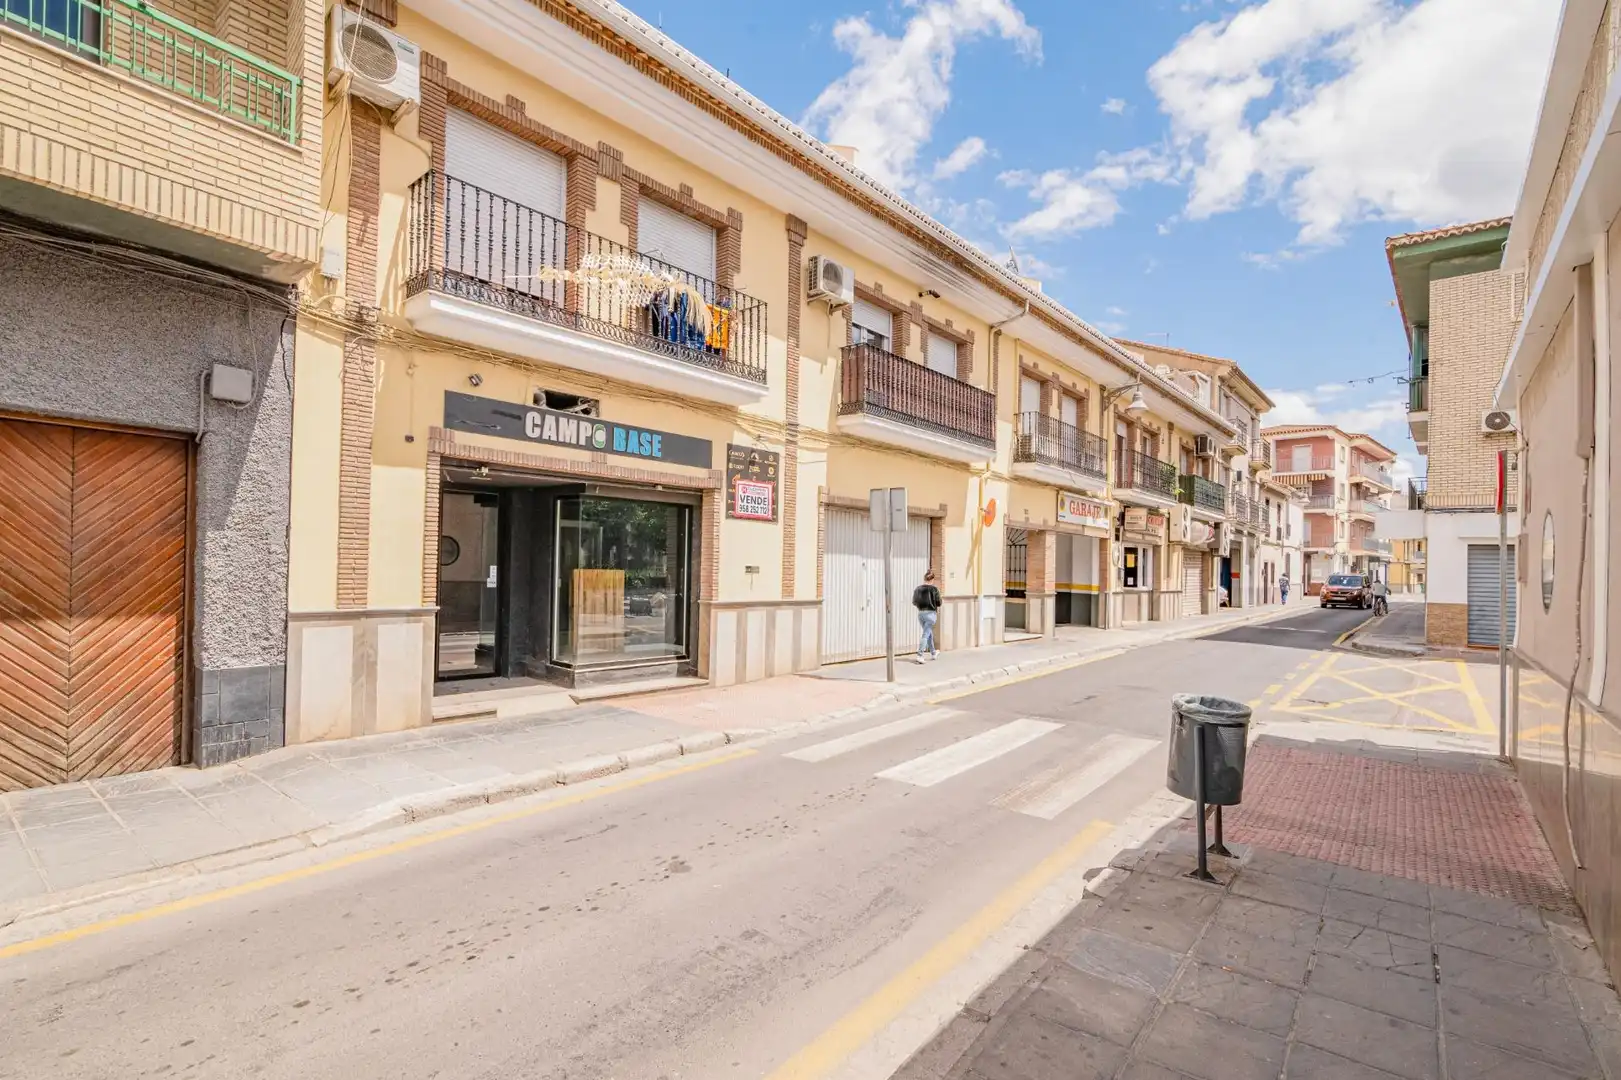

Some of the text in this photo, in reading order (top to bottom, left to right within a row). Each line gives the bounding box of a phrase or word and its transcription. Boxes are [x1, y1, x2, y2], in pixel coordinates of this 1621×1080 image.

[525, 411, 662, 457] CAMPO BASE
[739, 494, 768, 506] VENDE
[739, 504, 749, 513] 958
[750, 505, 759, 514] 252
[1069, 500, 1101, 518] GARAJE
